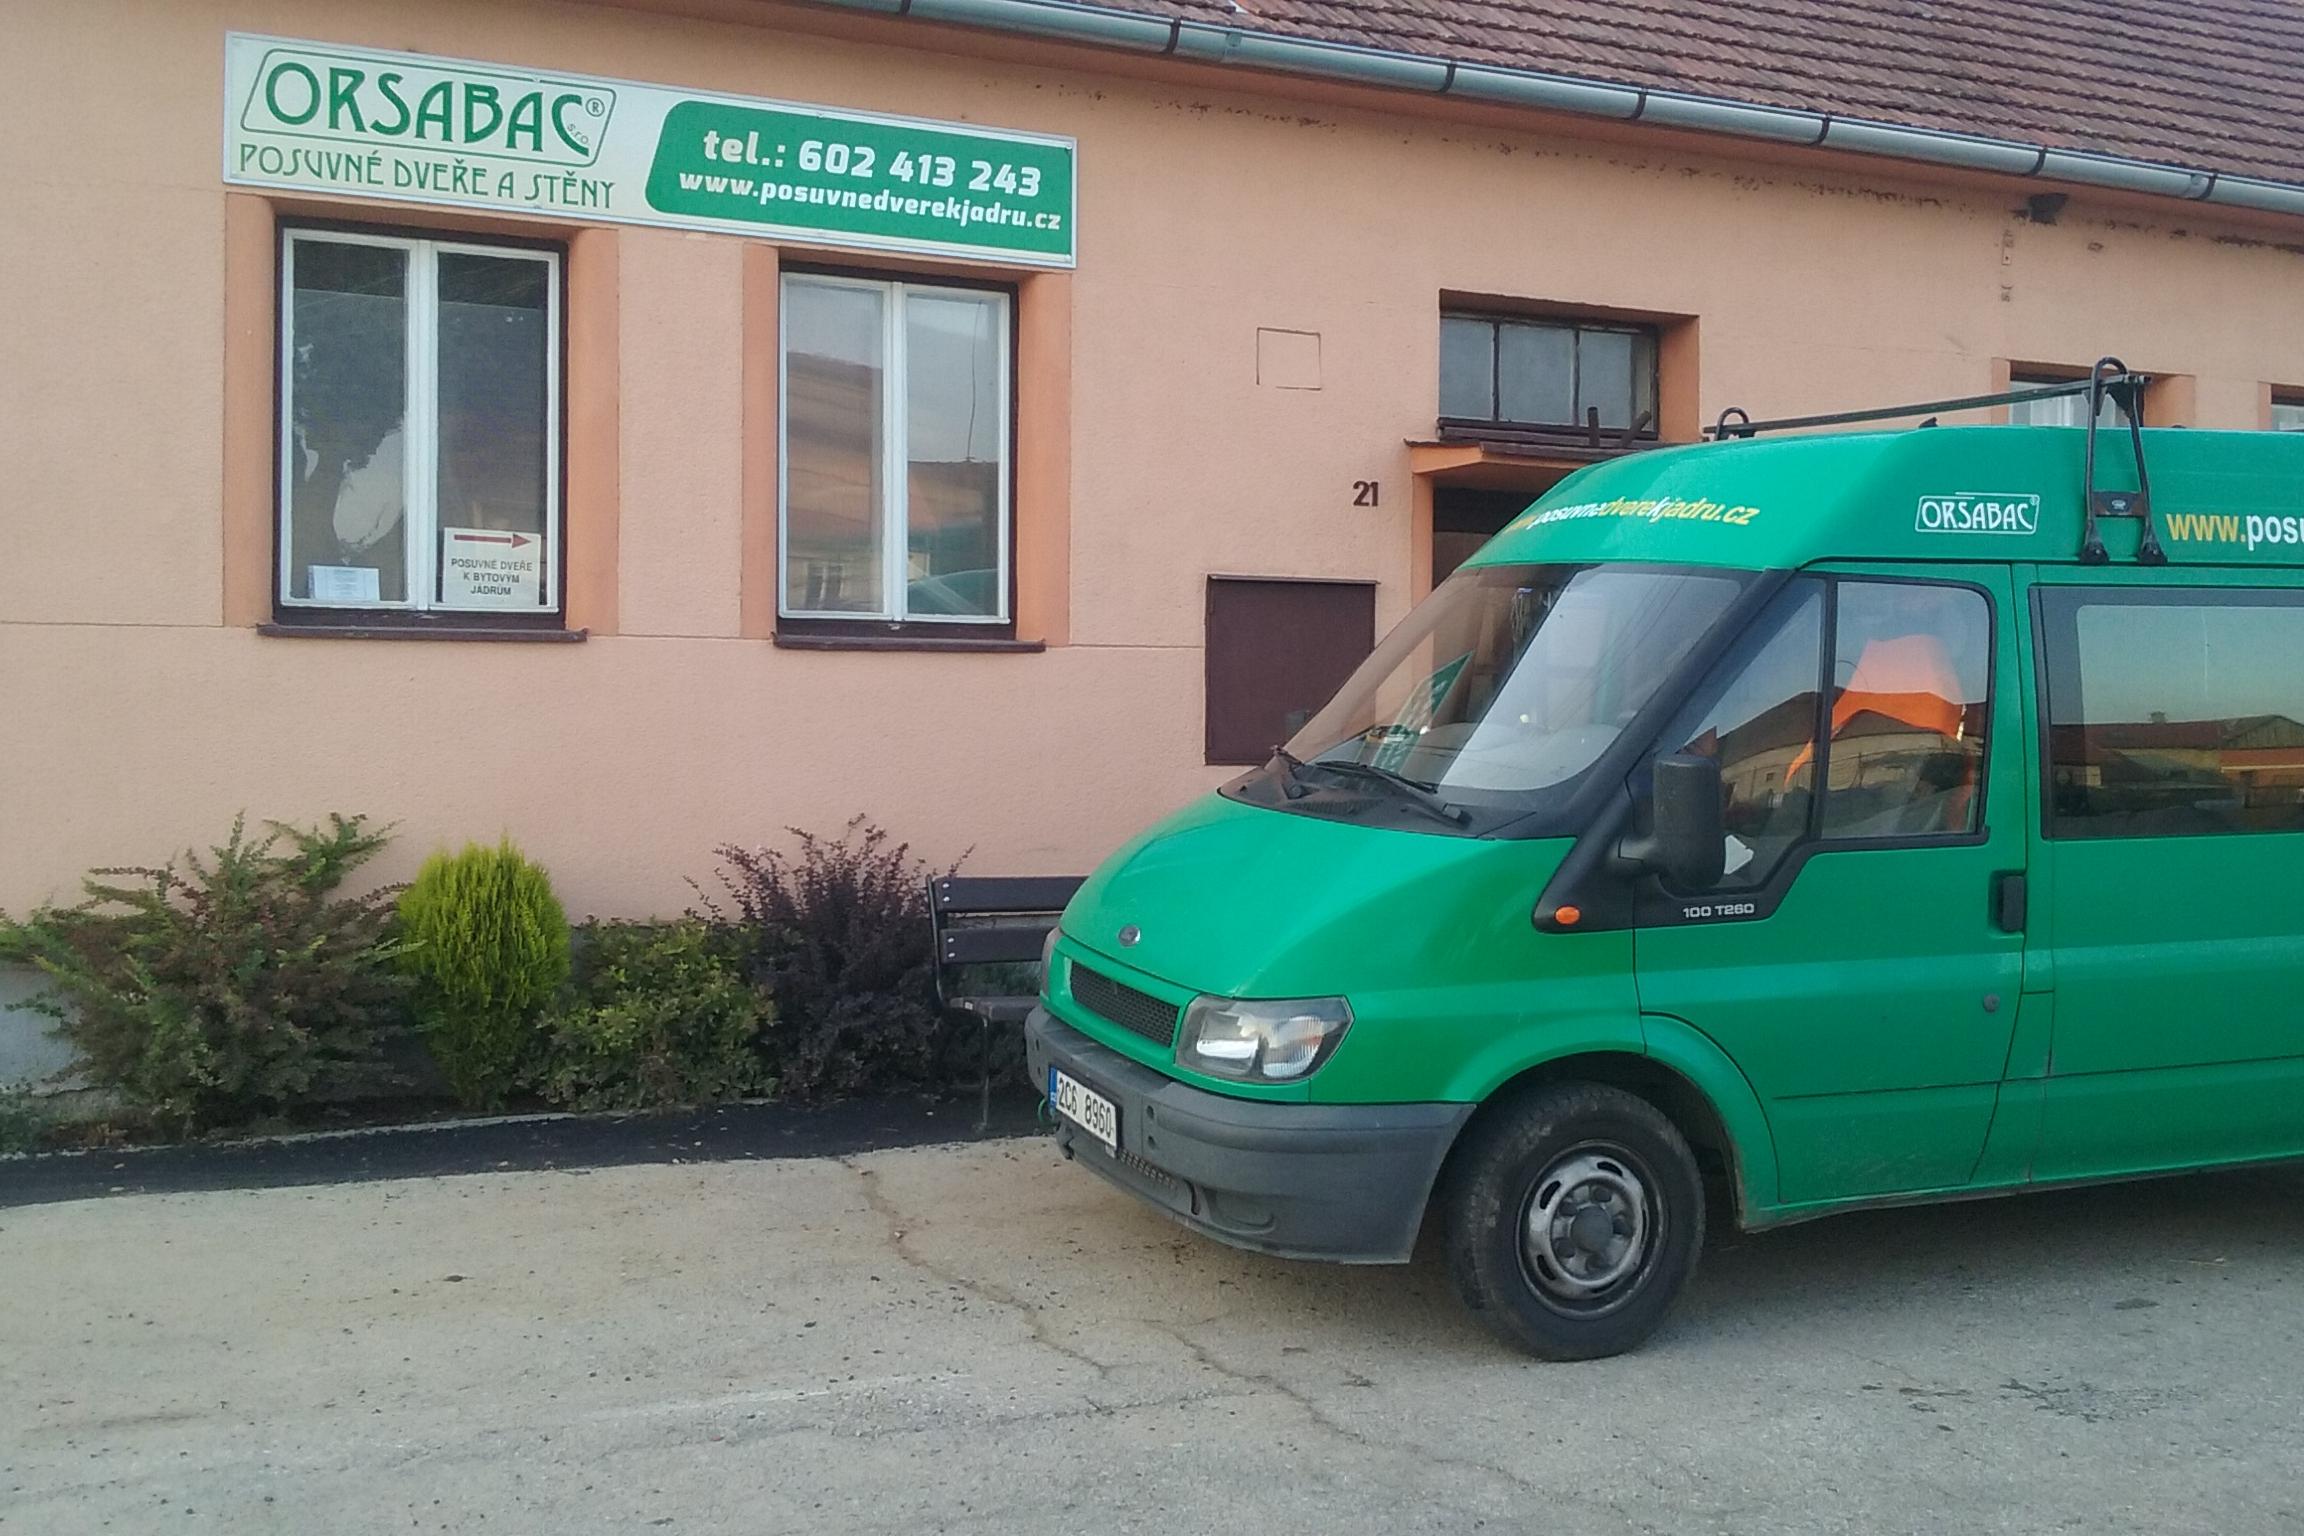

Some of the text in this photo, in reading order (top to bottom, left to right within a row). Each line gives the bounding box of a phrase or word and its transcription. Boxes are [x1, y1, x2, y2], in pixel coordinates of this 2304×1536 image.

[265, 61, 590, 157] ORSABAC
[239, 143, 616, 209] POSUVNÉ DVEŘE A STĚNY
[703, 130, 1041, 198] tel.: 602 413 243
[679, 171, 1061, 231] www.posuvnedverekjadru.cz
[1353, 480, 1379, 507] 21
[1921, 501, 2033, 531] ORSABAC
[463, 571, 470, 581] K
[1683, 903, 1755, 918] 100 T260
[1059, 1077, 1112, 1139] 2C6 8960
